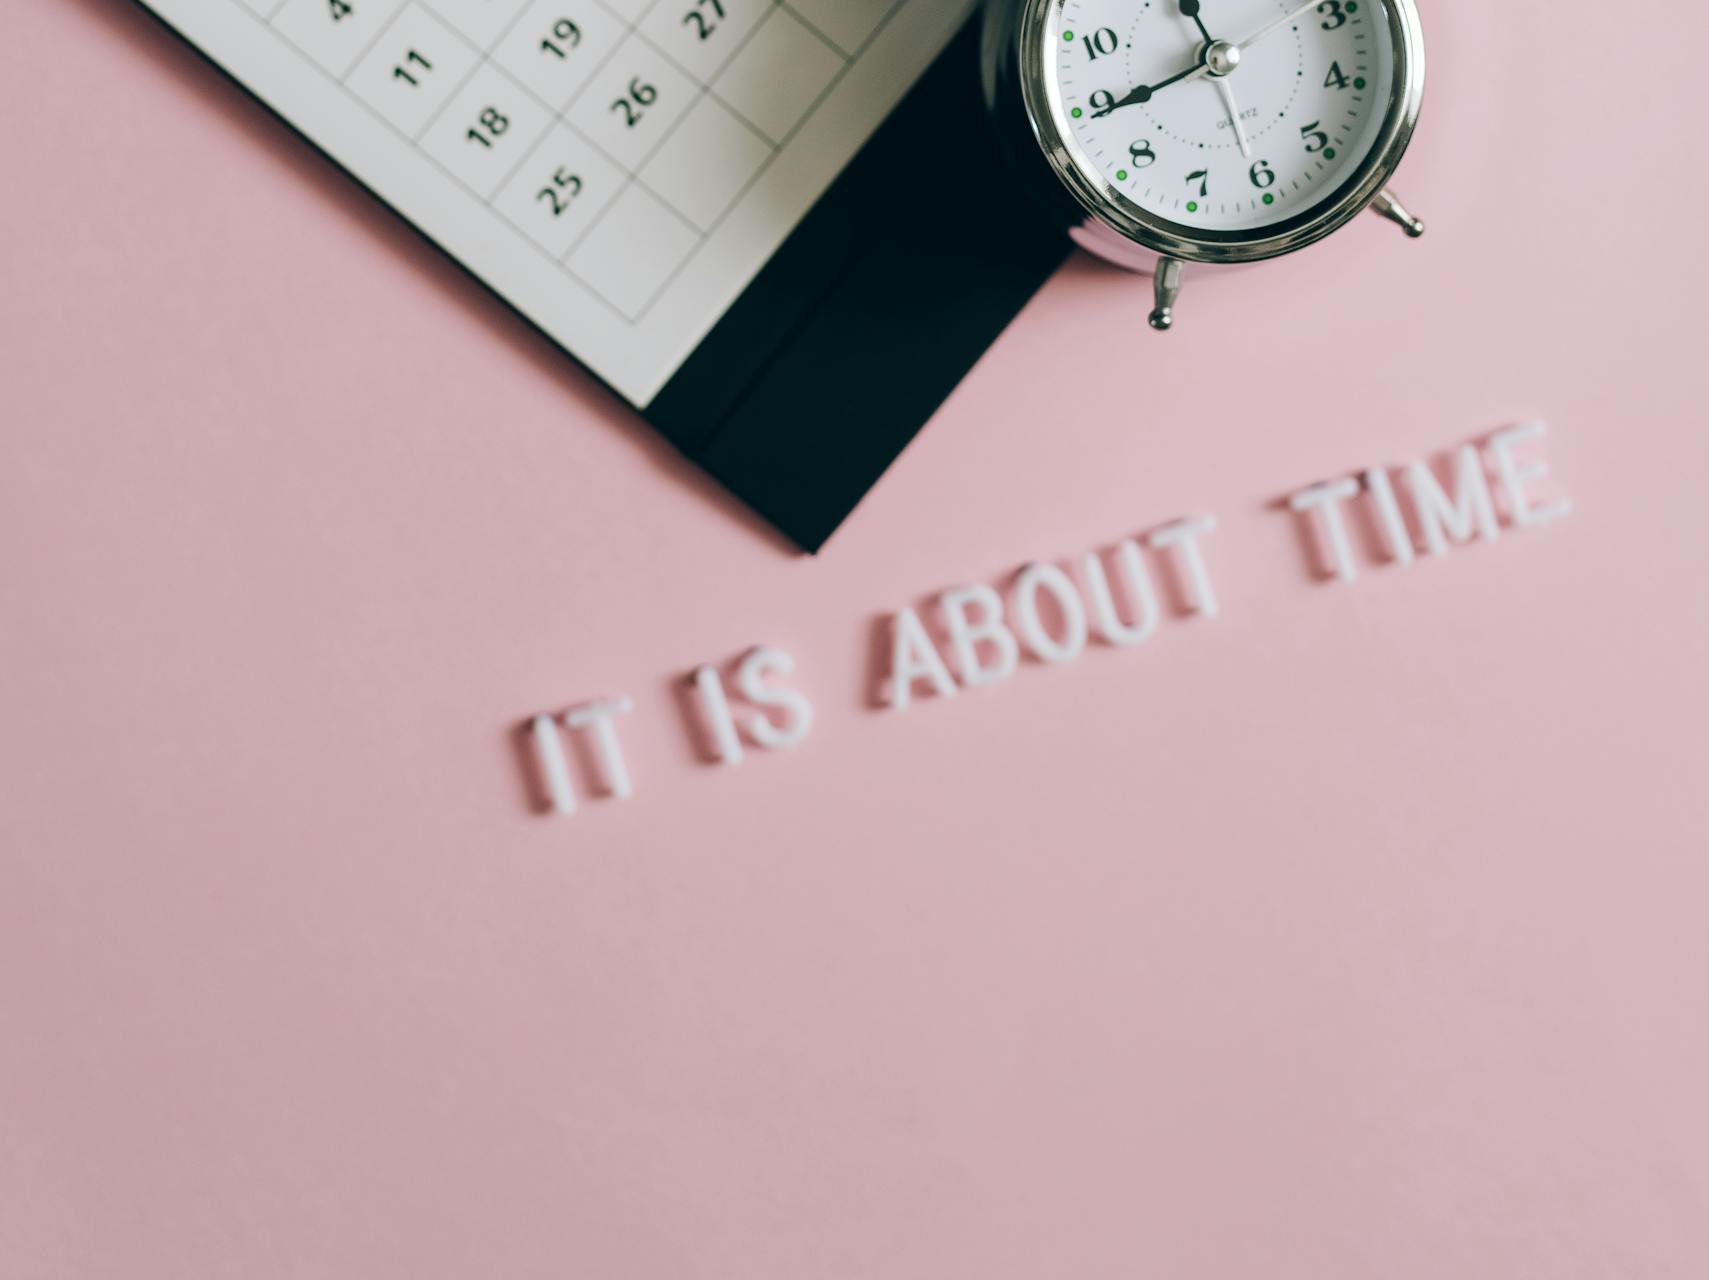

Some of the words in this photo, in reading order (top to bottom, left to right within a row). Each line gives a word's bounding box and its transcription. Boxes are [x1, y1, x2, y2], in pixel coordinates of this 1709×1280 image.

[1316, 0, 1347, 31] 3
[1081, 26, 1119, 62] 10
[391, 48, 434, 89] 11
[464, 106, 511, 151] 18
[538, 17, 583, 61] 19
[1322, 60, 1351, 91] 4
[1089, 89, 1115, 118] 9
[1215, 106, 1259, 130] QURTZ
[535, 167, 584, 217] 25
[609, 77, 659, 129] 26
[1300, 120, 1329, 154] 5
[1128, 138, 1157, 169] 8
[1185, 168, 1209, 198] 7
[1248, 159, 1276, 189] 6
[532, 695, 636, 816] IT
[694, 645, 814, 766] IS
[889, 511, 1220, 713] ABOUT
[1288, 418, 1575, 586] TIME
